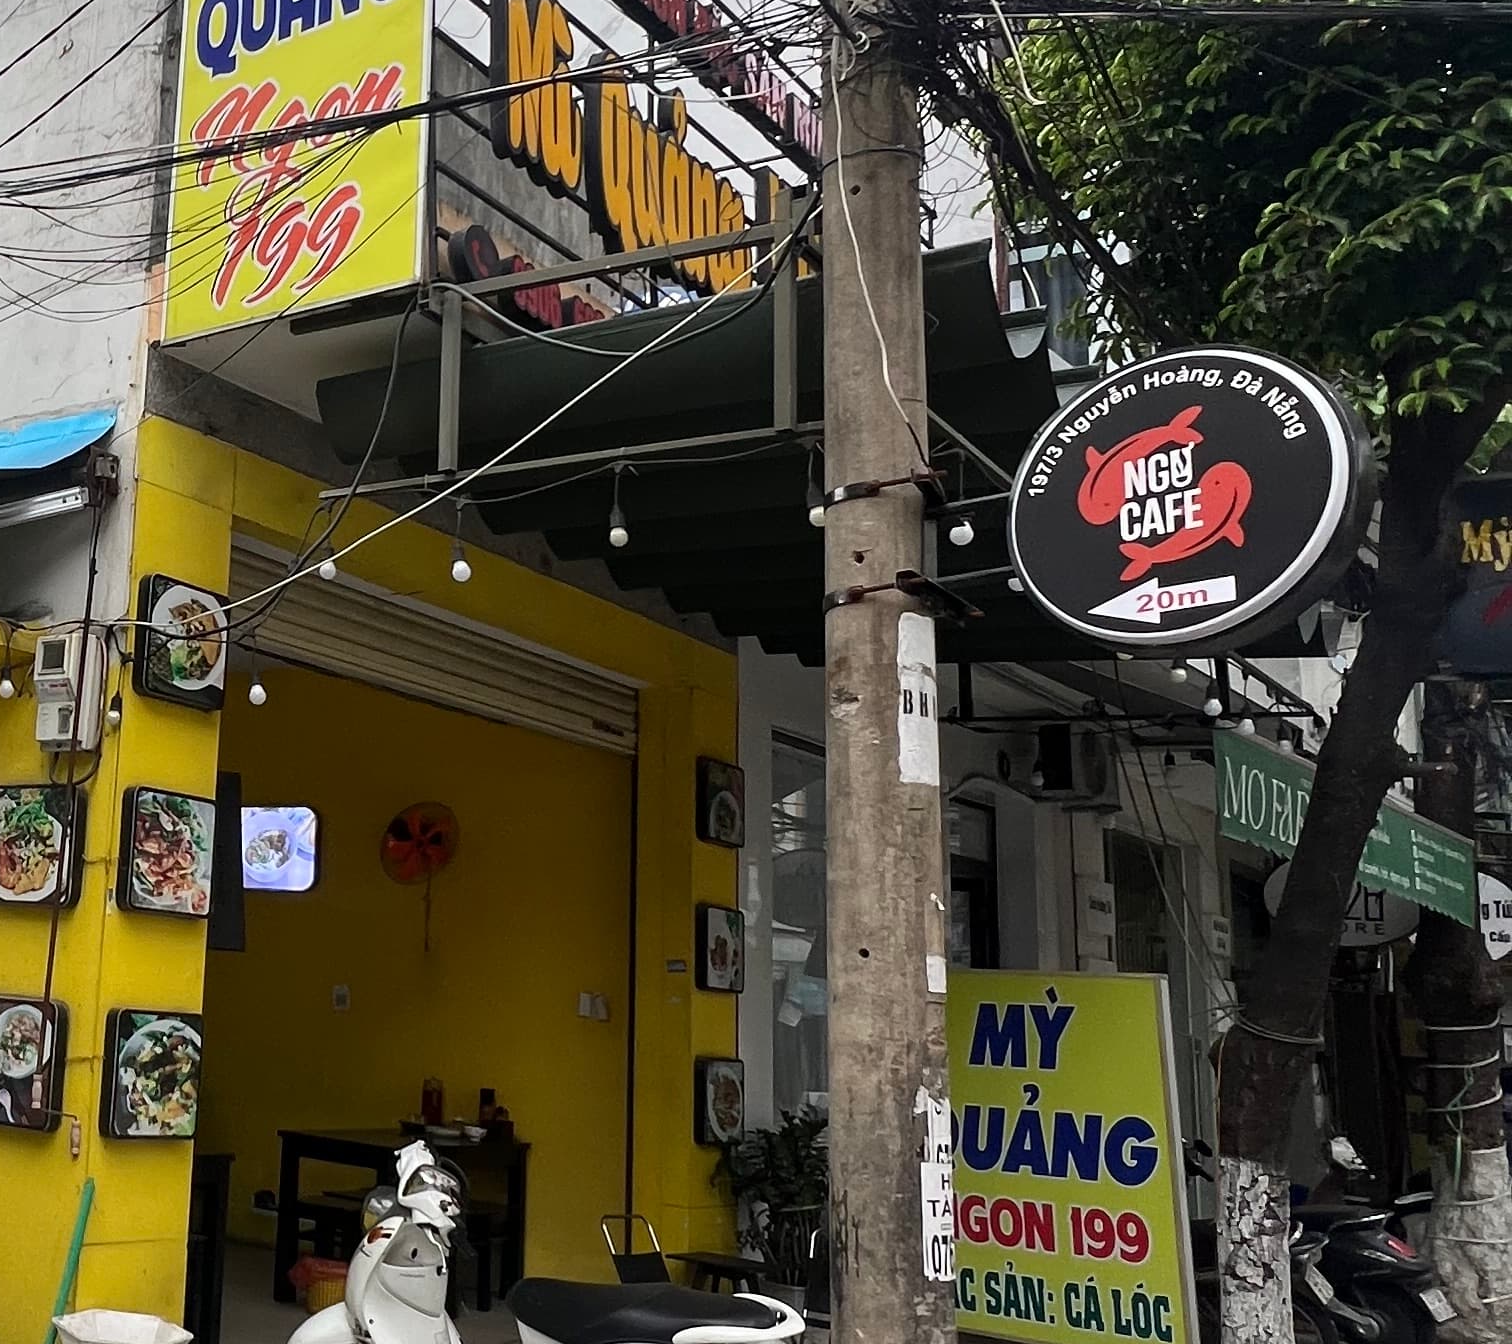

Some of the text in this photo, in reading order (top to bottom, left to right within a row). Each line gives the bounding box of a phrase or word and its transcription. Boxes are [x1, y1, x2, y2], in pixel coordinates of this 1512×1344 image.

[194, 67, 402, 222] Ngon
[211, 186, 361, 307] 199
[1028, 365, 1307, 497] 197/3 Nguyễn Hoàng, Đà Nẵng
[1119, 487, 1204, 542] CAFE
[1136, 587, 1209, 613] 20m
[969, 986, 1075, 1070] MỲ
[952, 1083, 1159, 1187] UẢNG
[953, 1194, 1150, 1264] GON 199
[984, 1260, 1056, 1324] SẢN:
[1064, 1276, 1105, 1332] CÁ
[1110, 1282, 1174, 1344] LÓC
